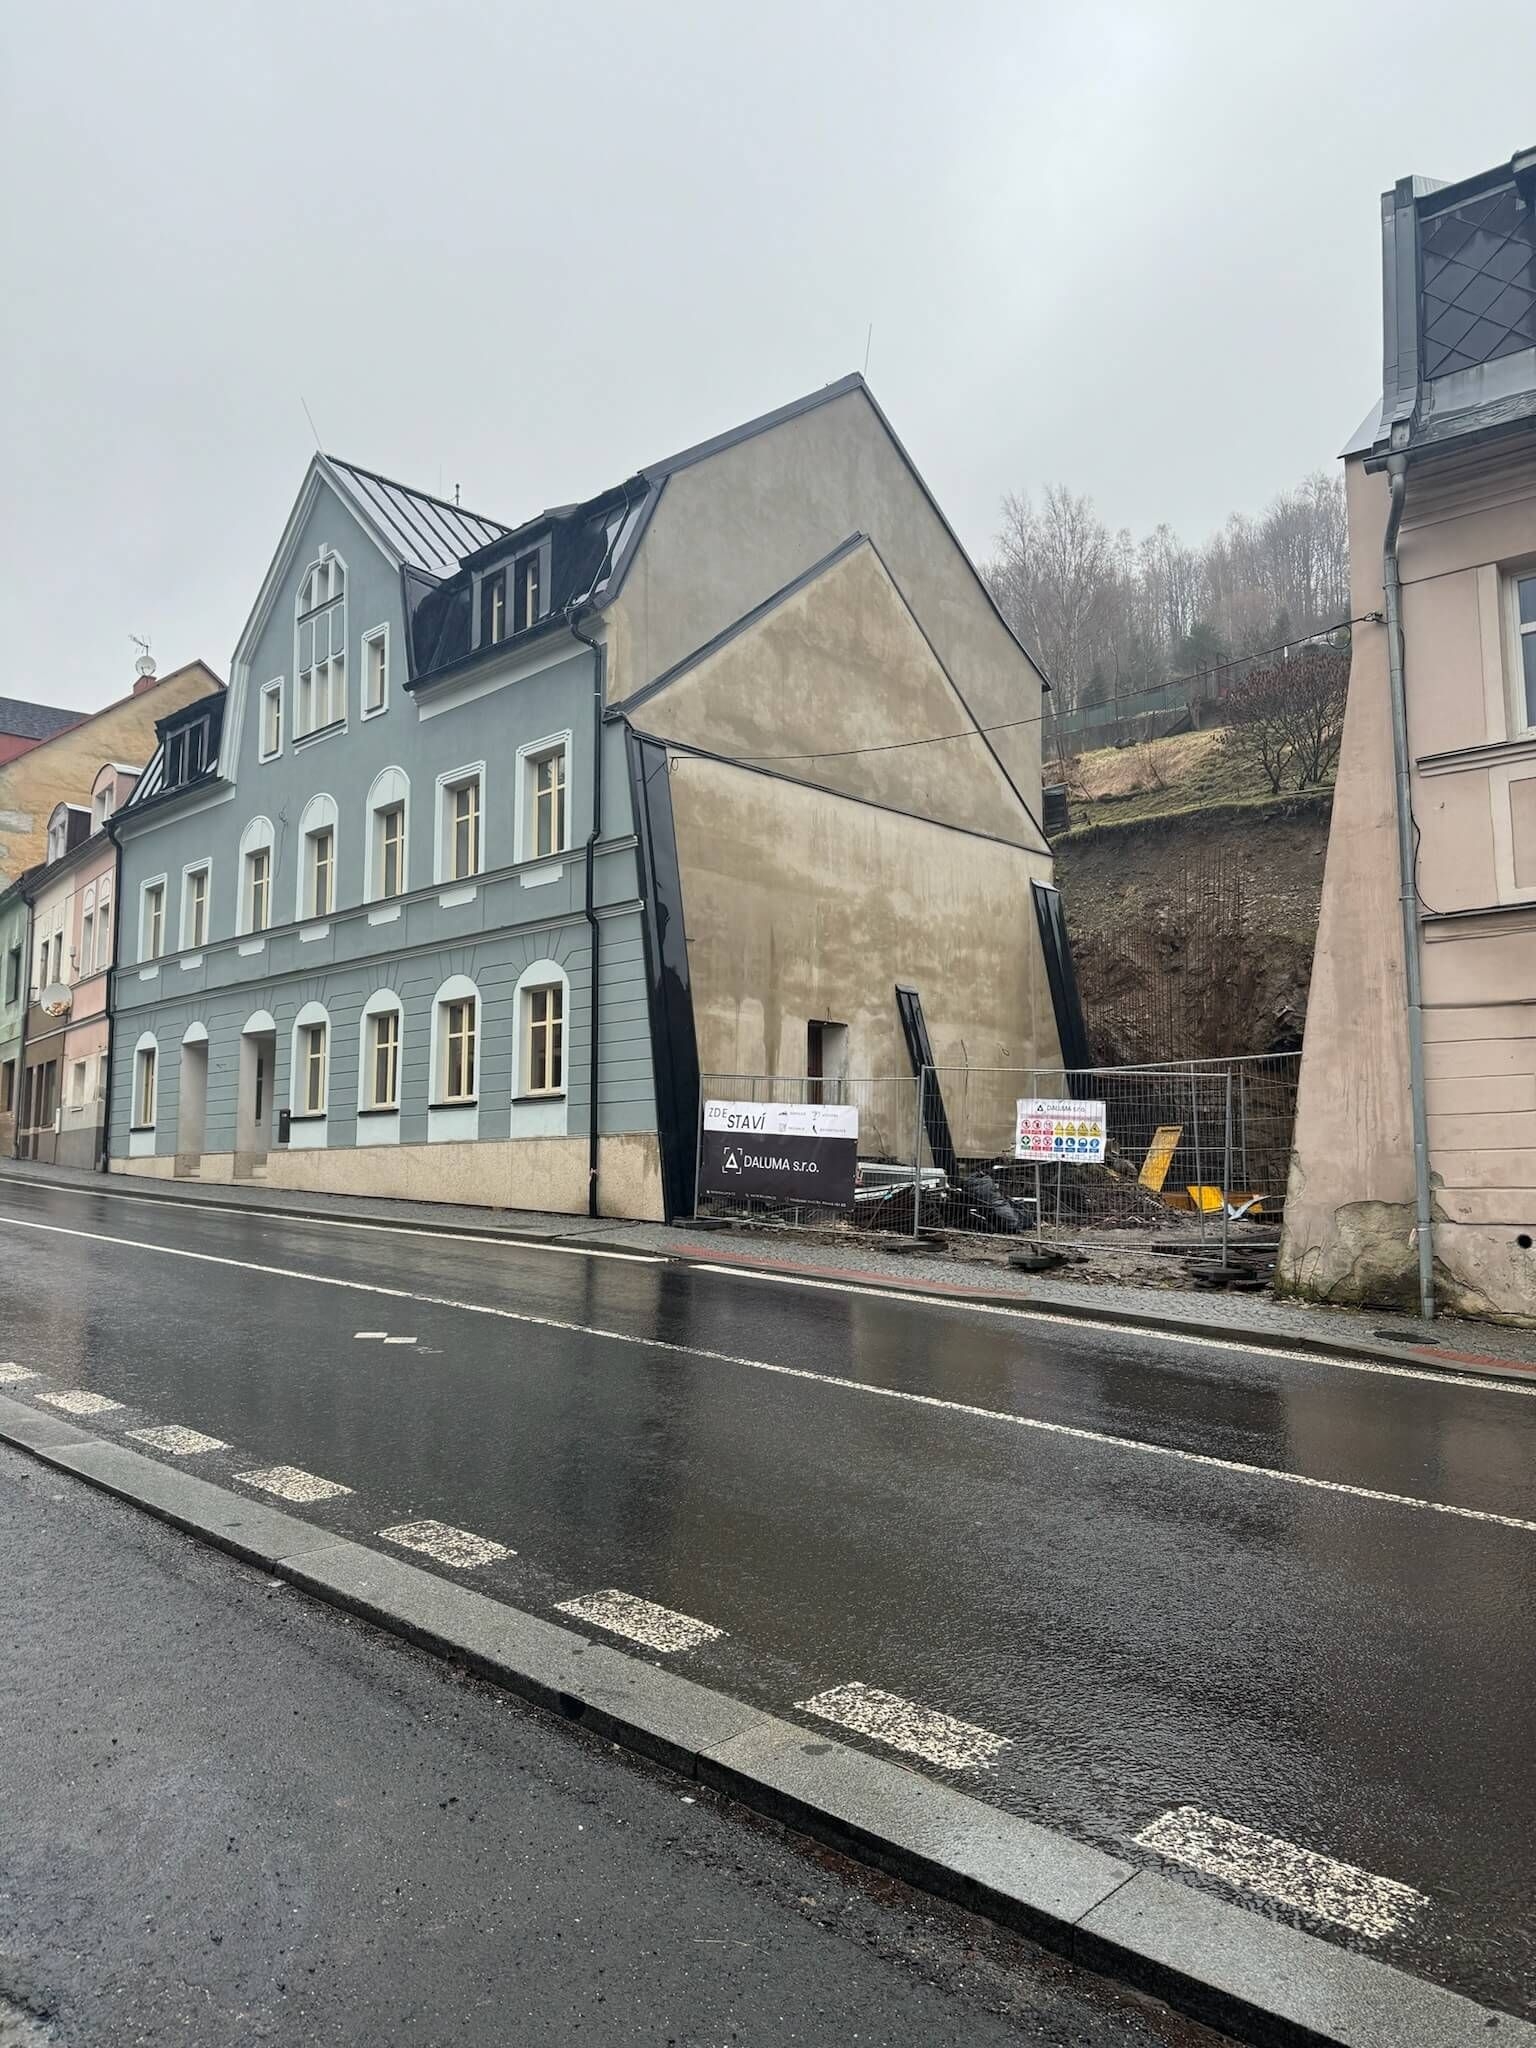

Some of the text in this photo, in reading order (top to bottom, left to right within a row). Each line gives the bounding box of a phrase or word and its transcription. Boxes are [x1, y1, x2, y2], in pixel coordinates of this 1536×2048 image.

[708, 1107, 727, 1118] ZDE
[727, 1112, 766, 1130] STAVÍ
[744, 1155, 820, 1173] DALUMA s.r.o.
